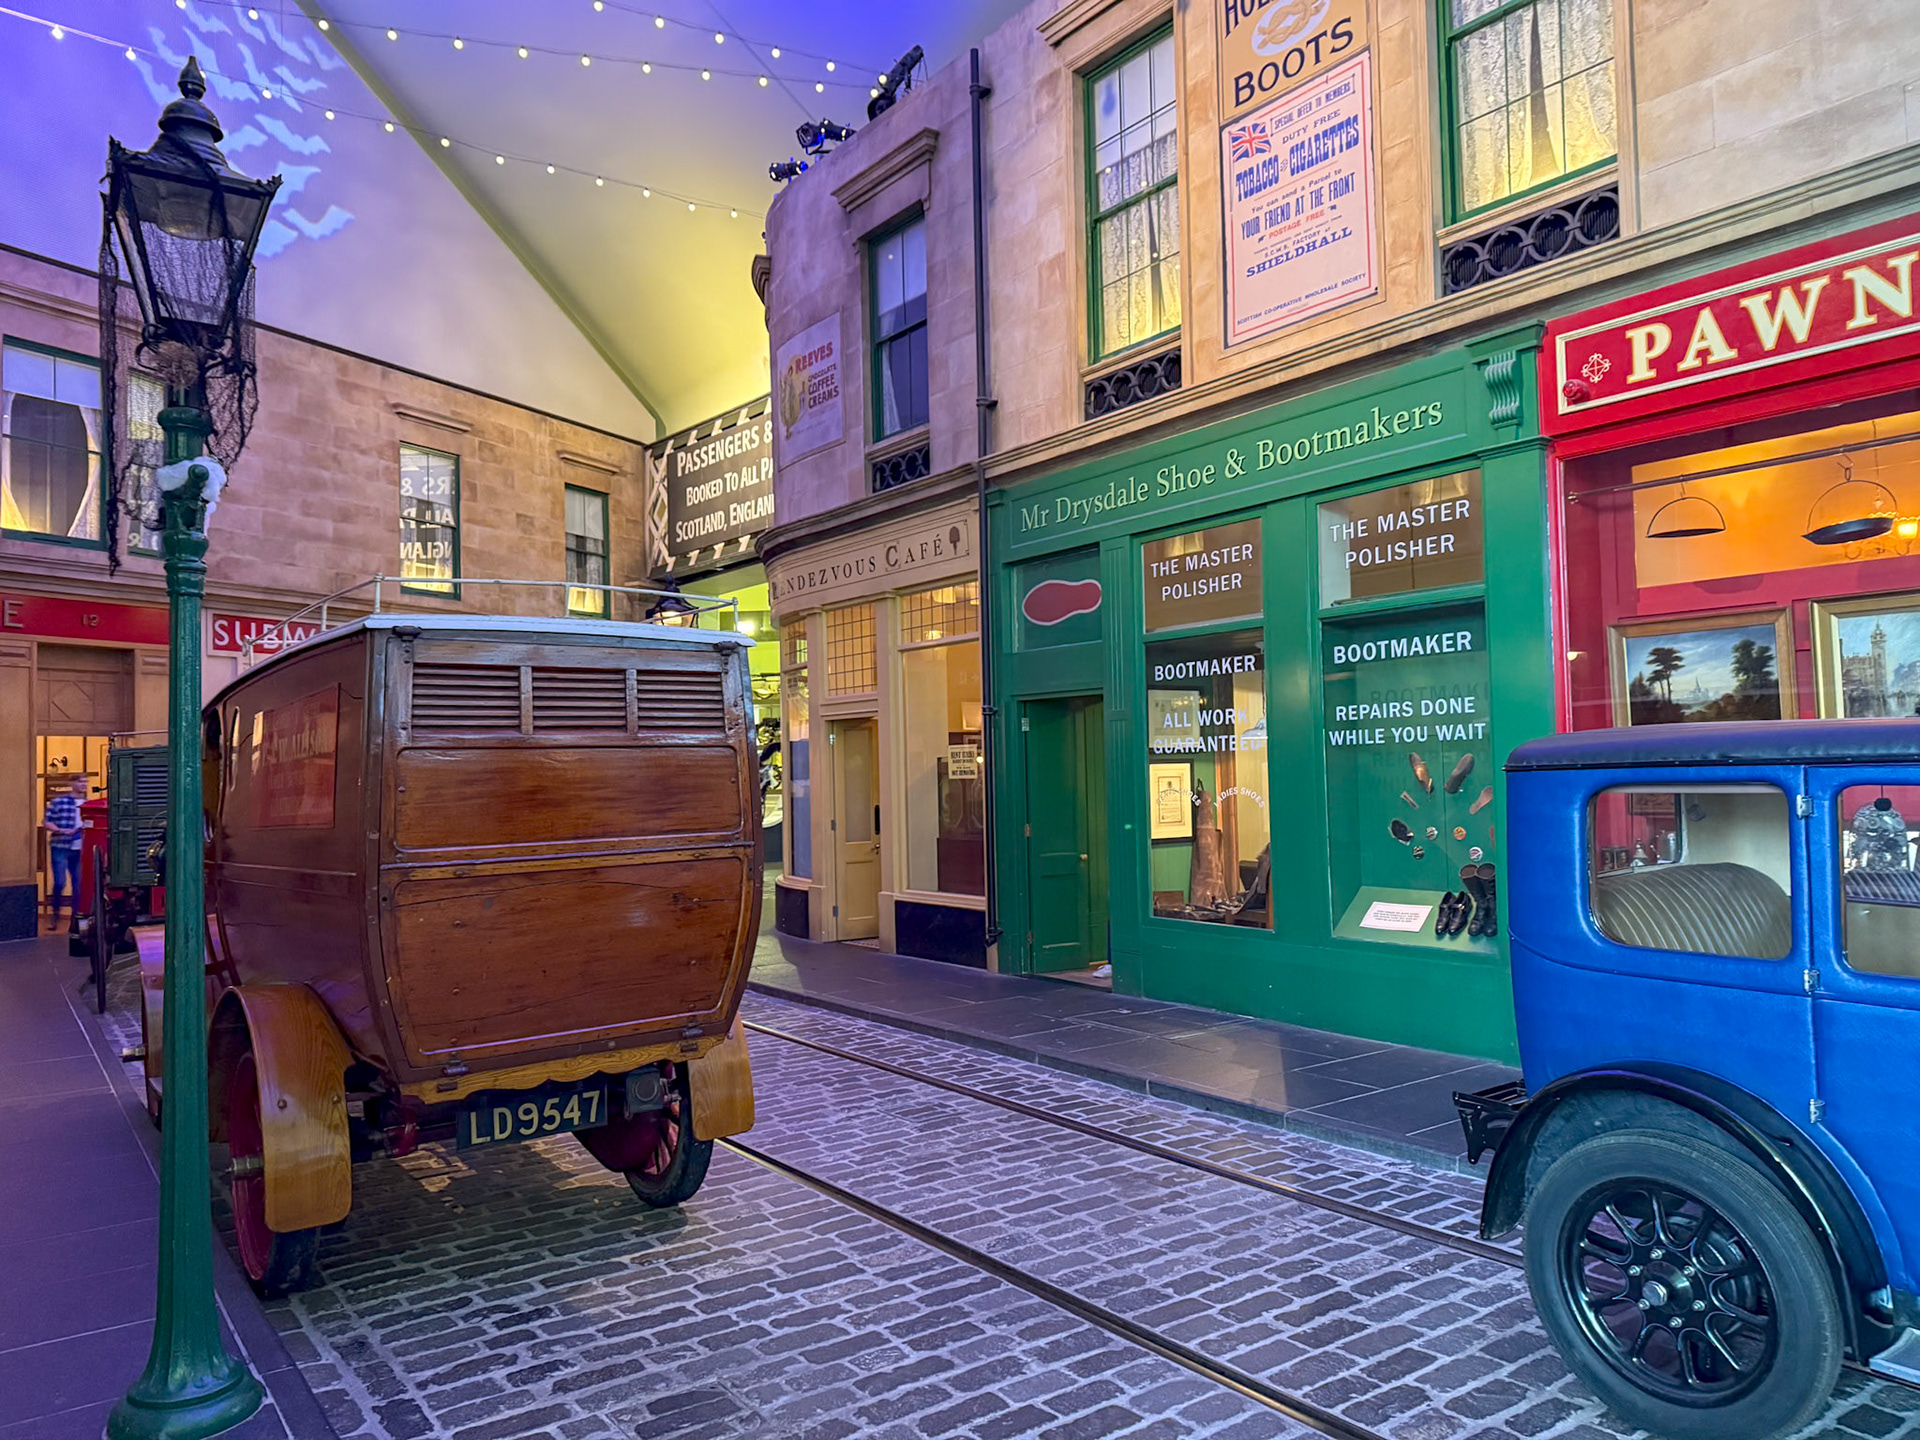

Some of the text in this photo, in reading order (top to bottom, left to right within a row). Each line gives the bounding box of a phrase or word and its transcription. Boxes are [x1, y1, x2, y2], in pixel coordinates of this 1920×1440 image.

[1234, 16, 1354, 108] BOOTS
[1274, 82, 1351, 130] SPECIAL OFFER TO MEMBERS
[1282, 109, 1341, 144] DUTY FREE
[1236, 154, 1279, 202] TOBACCO
[1289, 114, 1359, 177] CIGARETTES
[1241, 172, 1355, 240] YOUR FRIEND AT THE FRONT
[1251, 205, 1263, 214] You
[1266, 198, 1278, 207] can
[1282, 188, 1297, 200] send
[1308, 172, 1331, 187] Parcel
[1268, 219, 1302, 240] POSTAGE
[1306, 209, 1325, 222] FREE
[1293, 230, 1321, 246] FACTORY
[1246, 226, 1352, 278] SHIELDHALL
[1237, 312, 1262, 326] SCOTTISH
[1264, 297, 1302, 315] CO-OPERATIVE
[1304, 283, 1338, 300] WHOLESALE
[1341, 273, 1366, 286] SOCIETY
[1625, 250, 1919, 385] PAWN
[795, 342, 834, 374] REEVES
[808, 373, 836, 396] COFFEE
[808, 386, 840, 409] CREAMS
[677, 420, 773, 478] PASSENGERS &
[1020, 400, 1444, 533] Mr Drysdale Shoe & Bootmakers
[686, 482, 723, 507] BOOKED
[724, 471, 739, 494] TO
[740, 465, 760, 489] ALL
[675, 510, 728, 543] SCOTLAND,
[1329, 499, 1471, 543] THE MASTER
[772, 534, 944, 600] RENDEZVOUS CAFÉ
[1150, 543, 1253, 579] THE MASTER
[1345, 533, 1455, 570] POLISHER
[1161, 572, 1242, 601] POLISHER
[82, 613, 98, 627] 12
[1333, 631, 1472, 665] BOOTMAKER
[1154, 654, 1256, 682] BOOTMAKER
[1163, 707, 1248, 729] ALL WORK
[1335, 696, 1476, 722] REPAIRS DONE
[1153, 735, 1263, 755] GUARANTEED
[1328, 722, 1486, 746] WHILE YOU WAIT
[1213, 786, 1266, 809] LADIES SHOES
